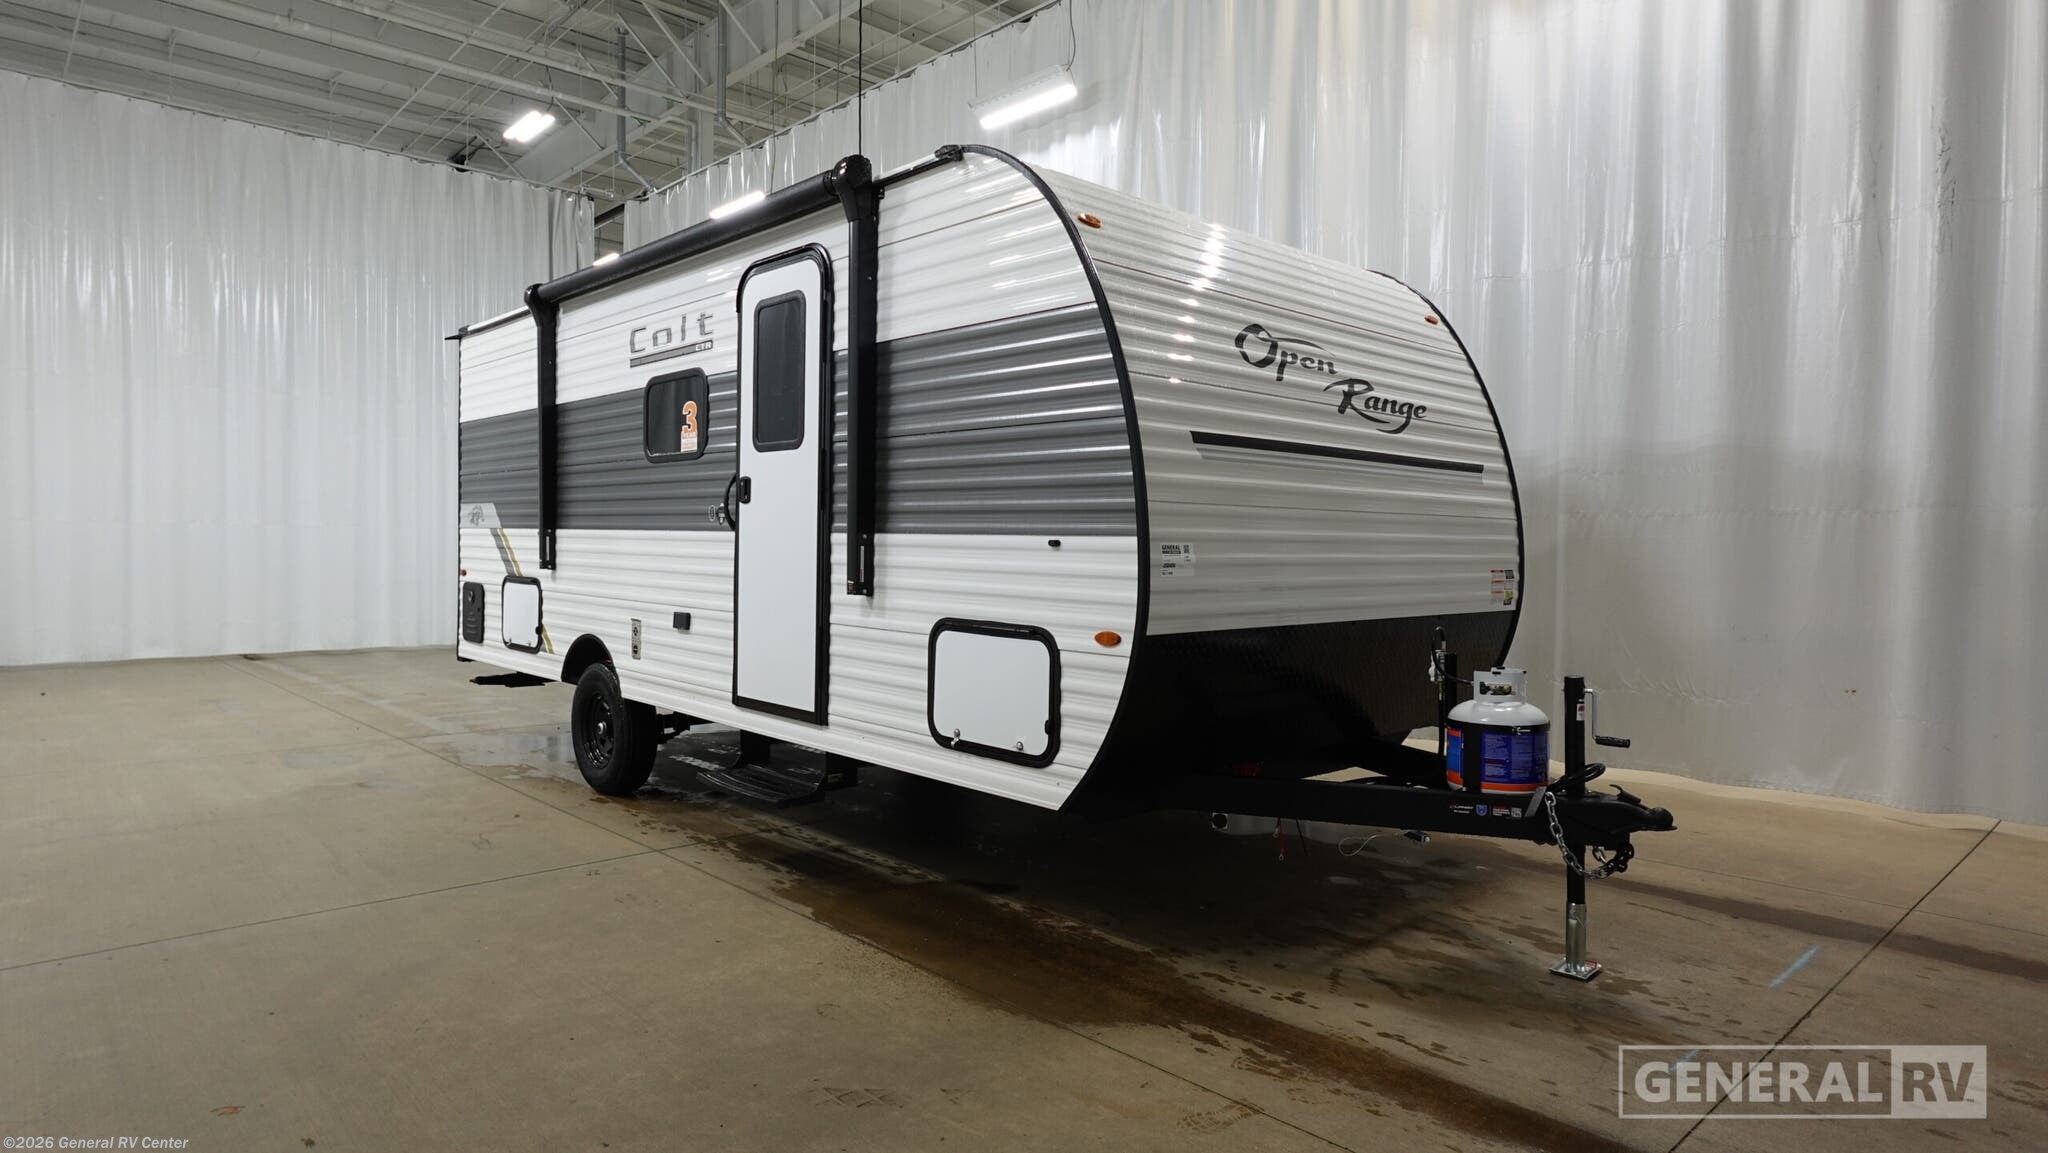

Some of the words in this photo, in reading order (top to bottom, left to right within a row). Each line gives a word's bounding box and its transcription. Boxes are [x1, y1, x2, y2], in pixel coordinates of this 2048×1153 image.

[629, 313, 713, 353] Colt
[1234, 323, 1338, 381] Open
[682, 400, 698, 433] 3
[1323, 378, 1427, 434] Range
